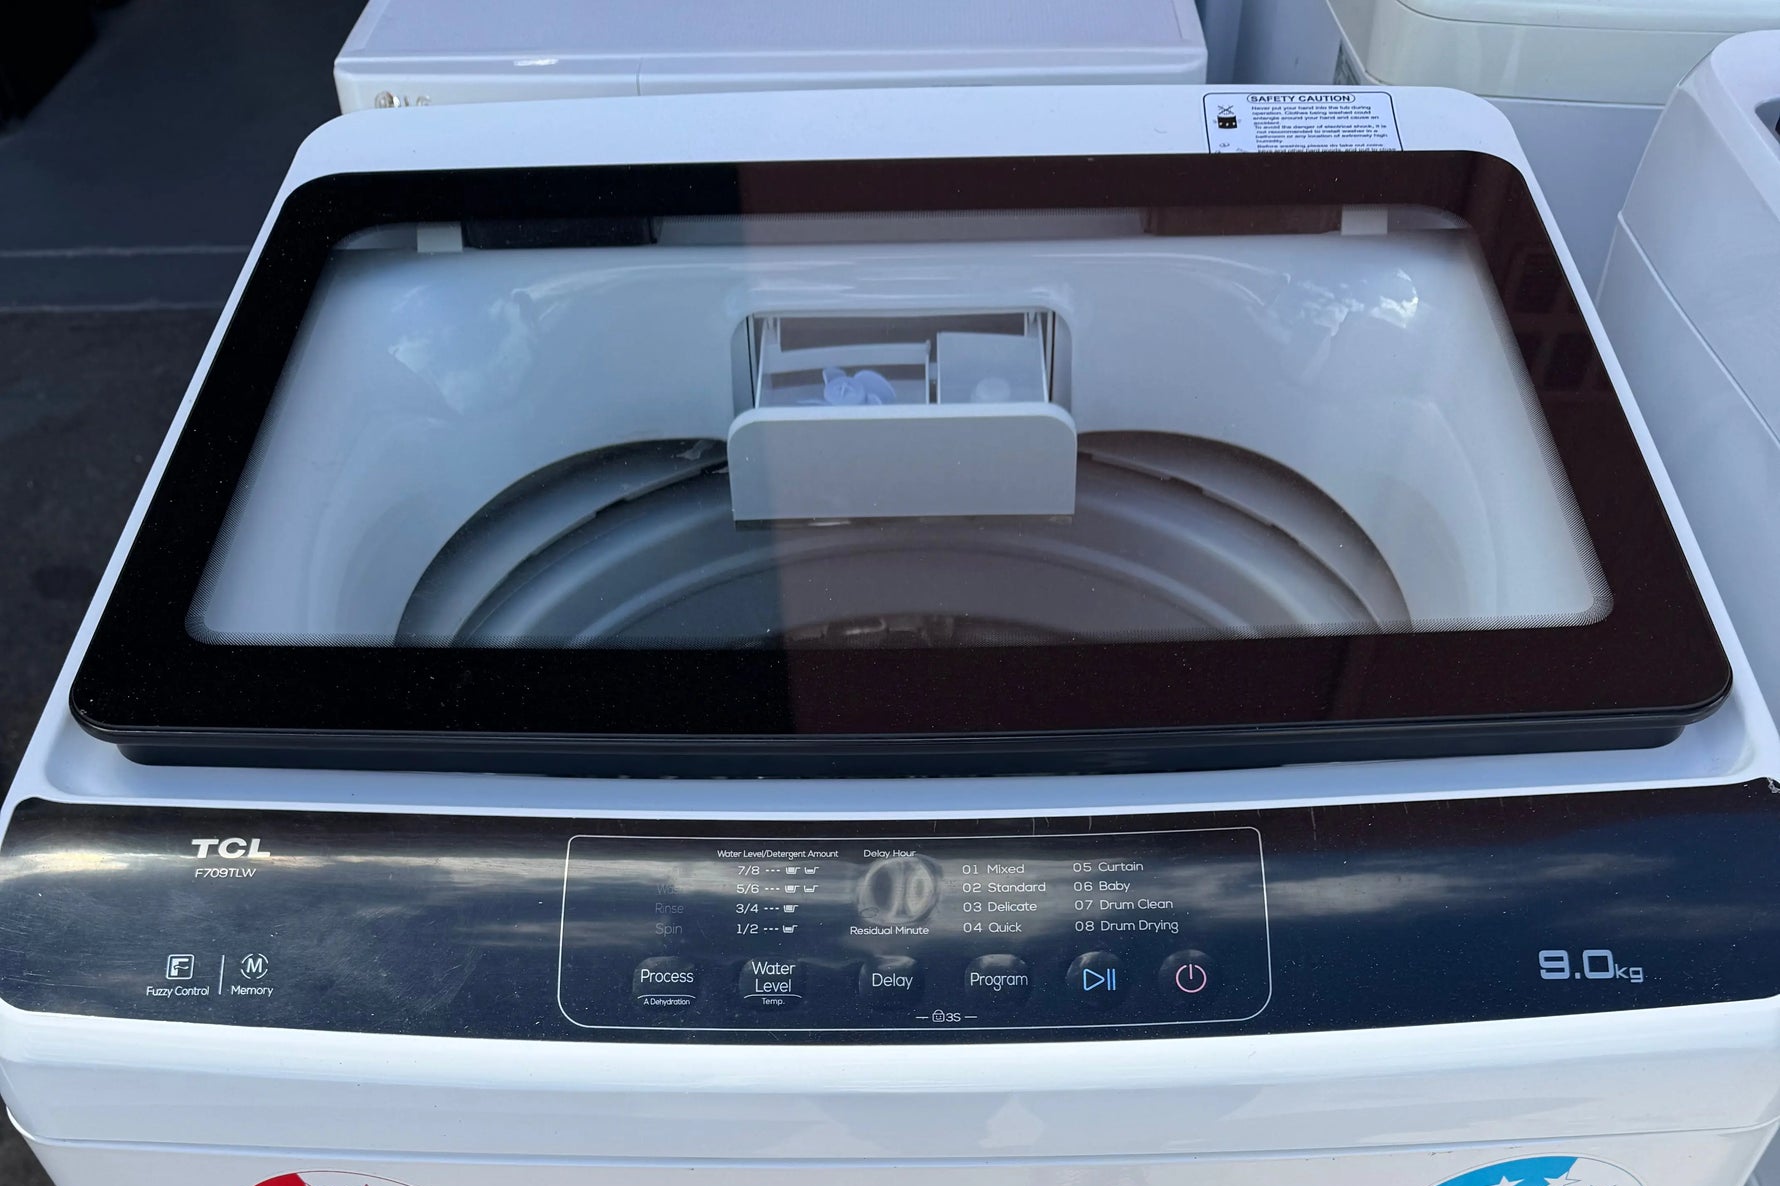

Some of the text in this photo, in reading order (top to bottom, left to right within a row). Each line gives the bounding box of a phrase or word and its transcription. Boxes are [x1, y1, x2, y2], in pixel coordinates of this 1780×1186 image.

[192, 838, 271, 859] TCL
[717, 850, 839, 860] Water Level/Detergent Amount
[864, 850, 891, 859] Delay
[737, 865, 760, 876] 7/8
[962, 864, 1025, 875] 01 Mixed
[1072, 862, 1144, 872] 05 Curtain
[195, 868, 256, 878] F709TLW
[736, 884, 760, 894] 5/6
[962, 882, 1046, 893] 02 Standard
[1073, 881, 1131, 893] 06 Baby
[655, 903, 684, 914] Rinse
[736, 904, 759, 914] 3/4
[963, 901, 1038, 912] 03 Delicate
[1074, 898, 1173, 911] 07 Drum Clean
[655, 924, 683, 936] Spin
[736, 924, 759, 935] 1/2
[850, 926, 929, 935] Residual Minute
[963, 922, 1022, 933] 04 Quick
[1075, 920, 1179, 933] 08 Drum Drying
[246, 958, 263, 973] M
[752, 962, 796, 975] Water
[640, 969, 694, 983] Process
[872, 973, 913, 990] Delay
[970, 972, 1028, 991] Program
[231, 986, 273, 997] Memory
[756, 979, 791, 993] Level
[146, 986, 209, 998] Fuzzy Control
[650, 998, 690, 1006] Dehydration
[762, 998, 785, 1006] Temp.
[946, 1012, 961, 1022] 3S
